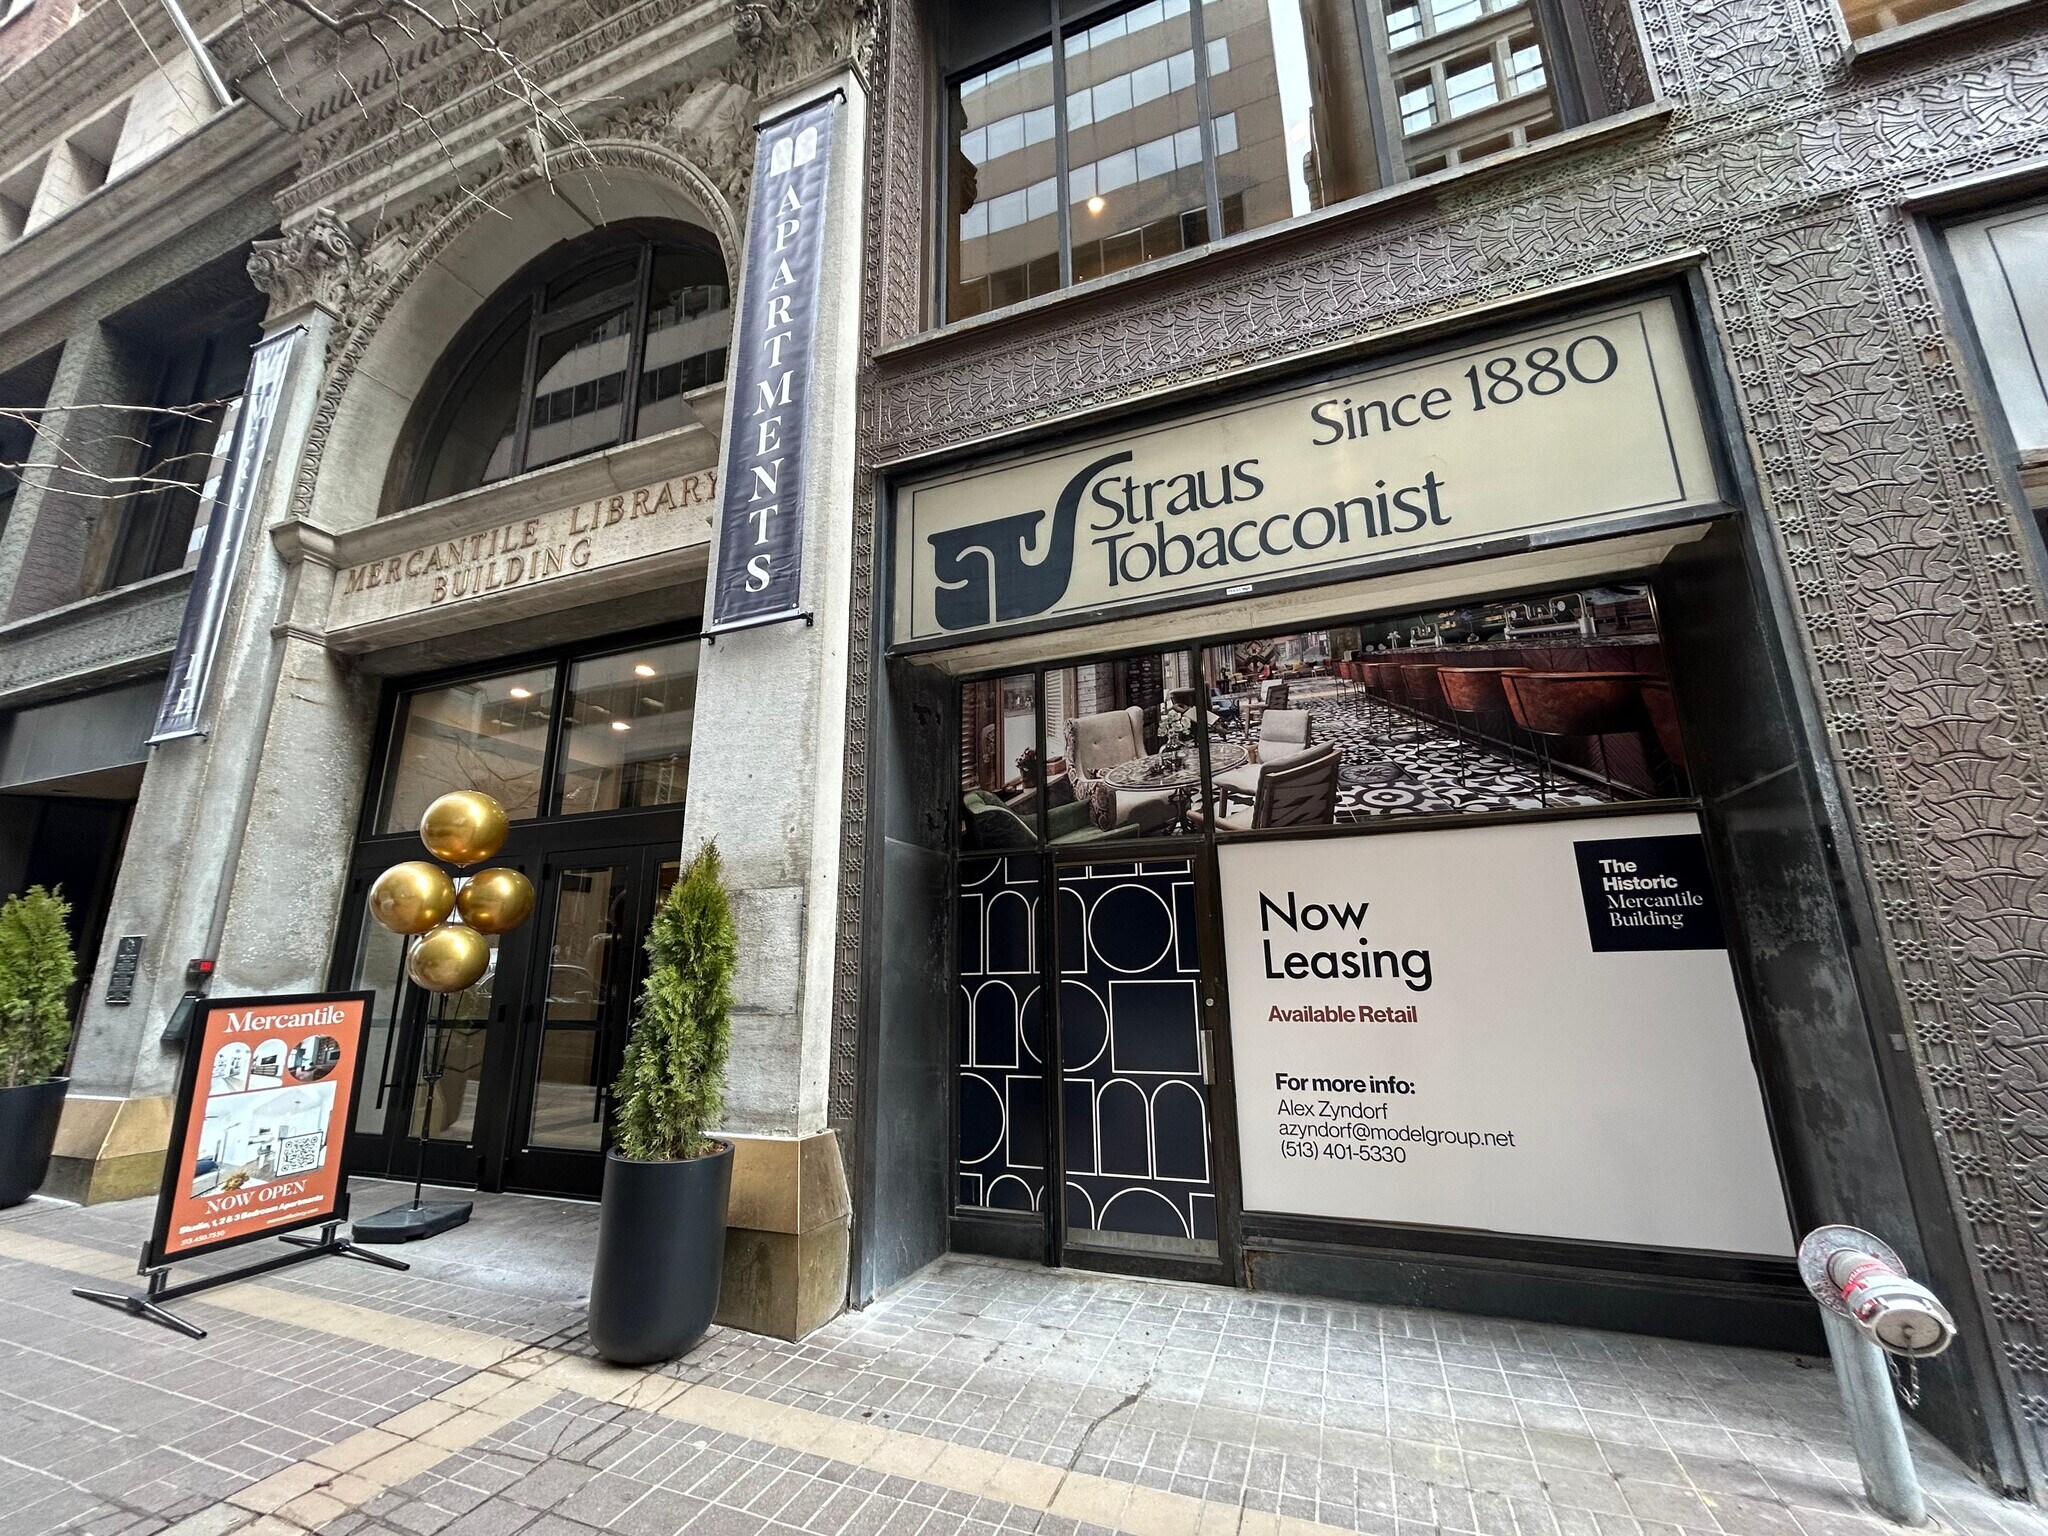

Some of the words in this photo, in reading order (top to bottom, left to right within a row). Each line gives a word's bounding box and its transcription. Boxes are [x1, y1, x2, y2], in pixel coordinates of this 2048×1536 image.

[746, 184, 804, 592] APARTMENTS
[1312, 388, 1451, 446] Since
[1465, 335, 1618, 411] 1880
[1091, 459, 1264, 531] Straus
[344, 518, 539, 595] MERCANTILE
[569, 471, 718, 536] LIBRARY
[1092, 472, 1451, 587] Tobacconist
[431, 537, 591, 604] BUILDING
[1599, 859, 1638, 874] The
[1602, 874, 1679, 891] Historic
[1259, 891, 1370, 932] Now
[1606, 891, 1704, 909] Mercantile
[1610, 911, 1684, 930] Building
[1263, 937, 1433, 992] Leasing
[223, 1005, 346, 1033] Mercantile
[1268, 1005, 1356, 1023] Available
[1358, 1005, 1418, 1023] Retail
[1275, 1073, 1309, 1091] For
[1312, 1078, 1366, 1093] more
[1369, 1075, 1416, 1095] info:
[1277, 1099, 1315, 1117] Alex
[1318, 1100, 1388, 1121] Zyndorf
[1279, 1122, 1516, 1149] azyndorf@modelgroup.net
[1281, 1140, 1319, 1161] (513)
[1323, 1143, 1407, 1164] 401-5330
[205, 1190, 255, 1215] NOW
[258, 1179, 308, 1202] OPEN
